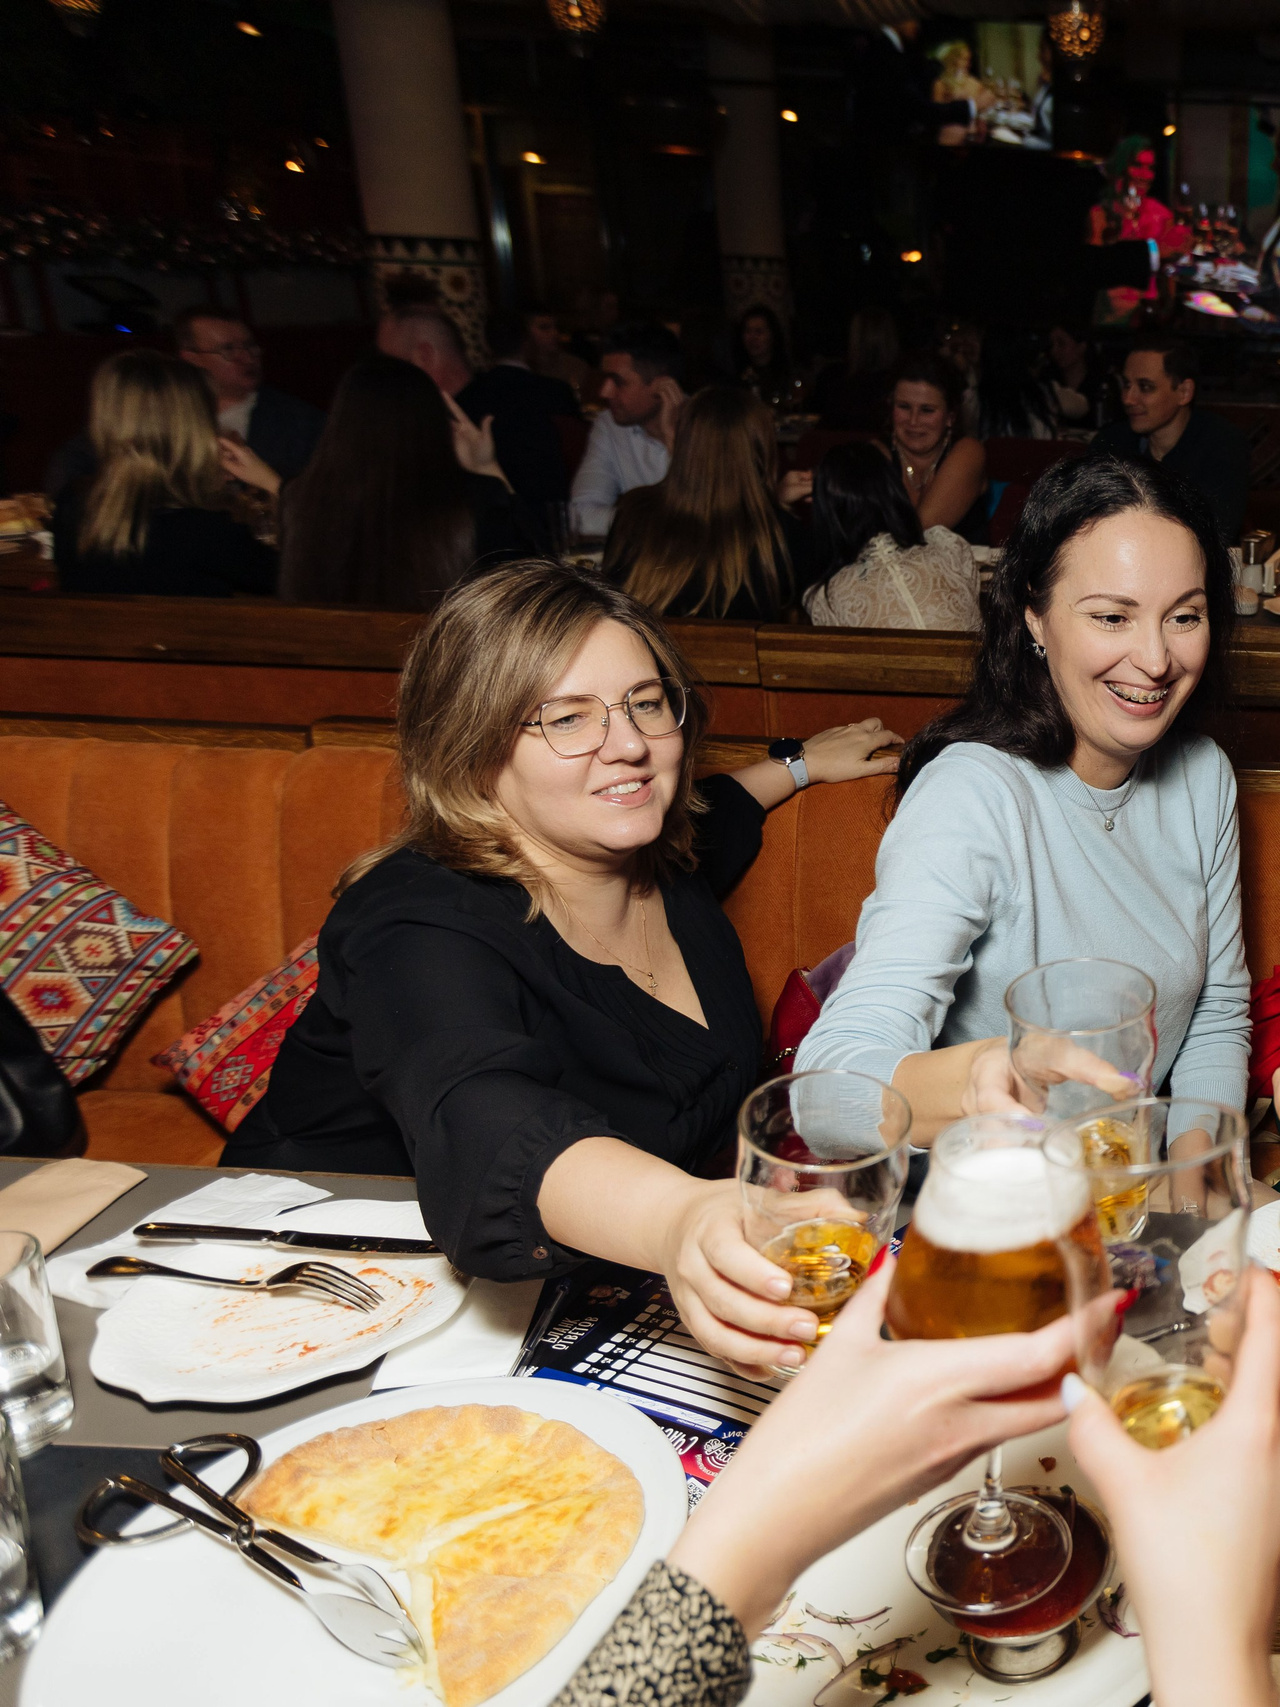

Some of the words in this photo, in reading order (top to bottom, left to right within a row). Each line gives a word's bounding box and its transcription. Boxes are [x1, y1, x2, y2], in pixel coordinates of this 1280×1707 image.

[540, 1317, 580, 1344] БЛАНК
[552, 1316, 599, 1350] ОТВЕТОВ
[660, 1427, 698, 1455] СЧАС
